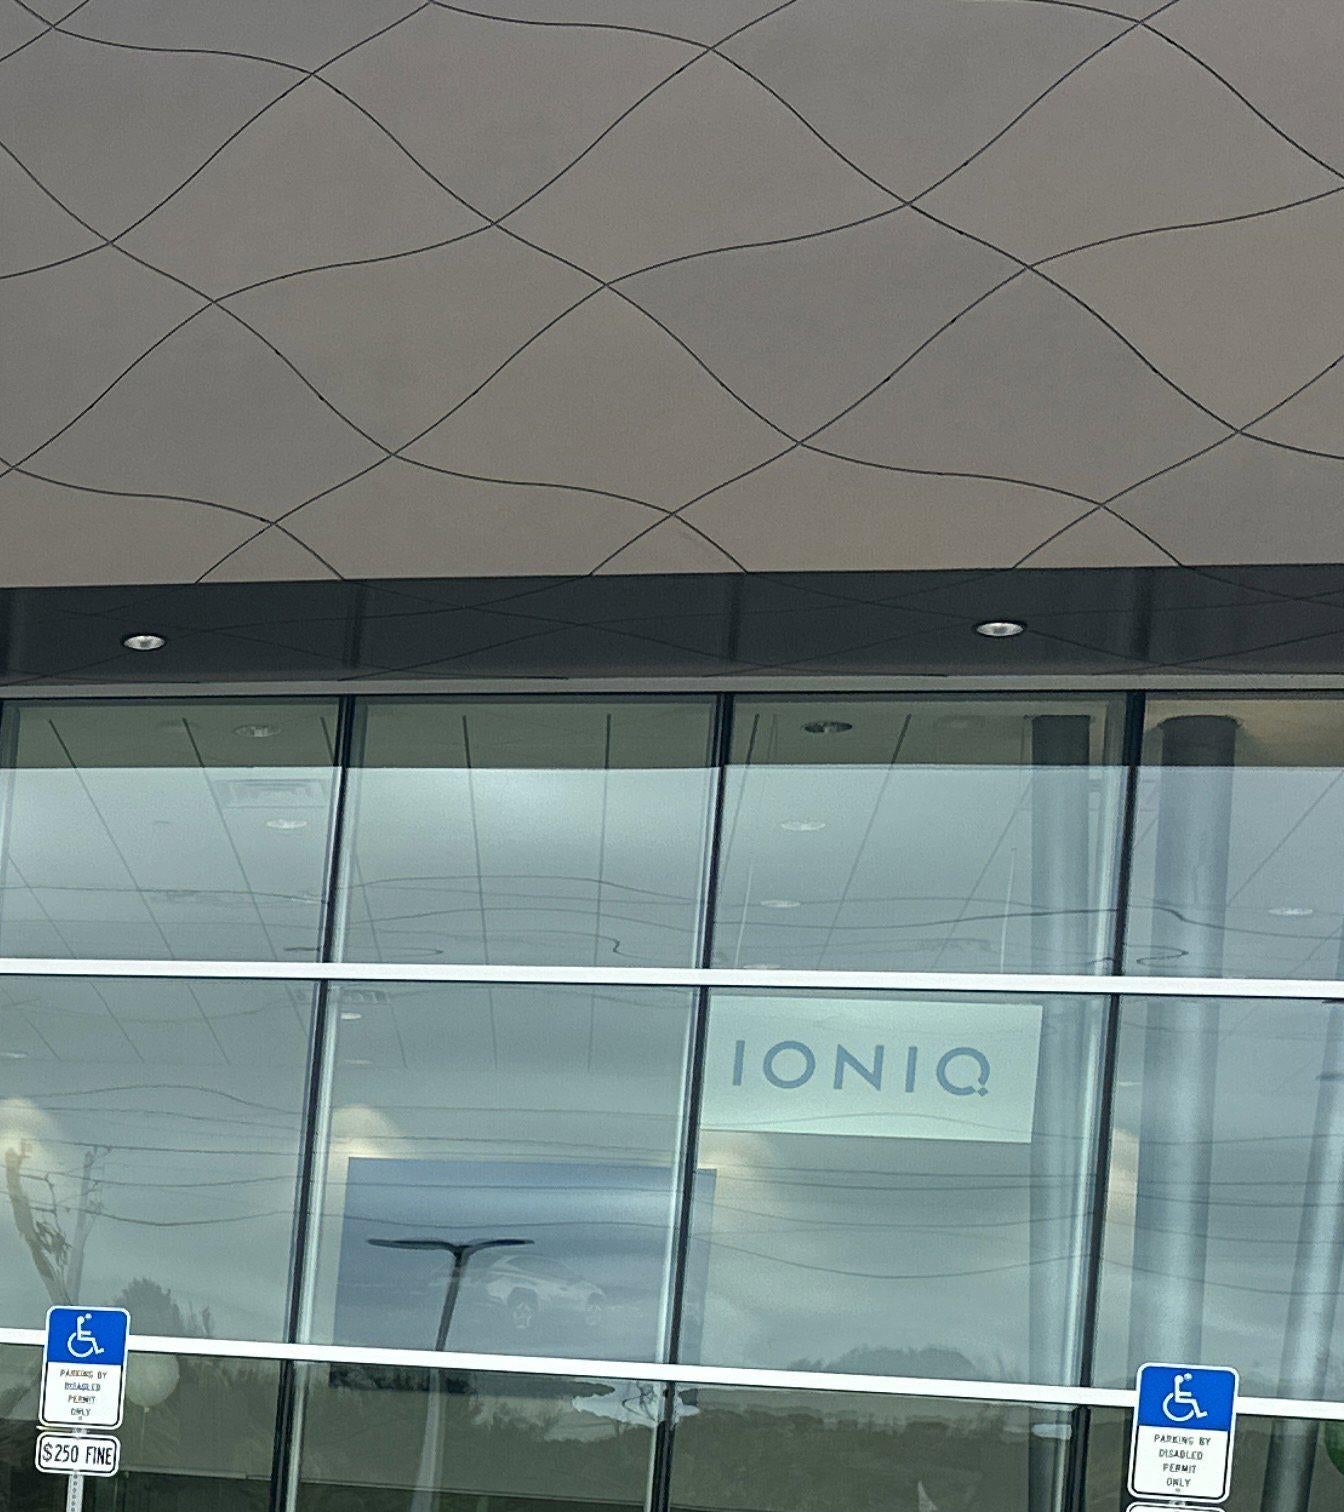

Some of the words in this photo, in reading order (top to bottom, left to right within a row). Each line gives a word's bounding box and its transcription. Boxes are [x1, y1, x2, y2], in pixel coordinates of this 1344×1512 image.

[732, 1039, 991, 1097] IONIQ
[60, 1369, 93, 1379] PARKING
[98, 1371, 107, 1379] BY
[68, 1395, 96, 1403] PERMIT
[71, 1408, 90, 1416] ONLY
[1154, 1434, 1194, 1445] PARKING
[1199, 1436, 1211, 1446] BY
[43, 1442, 78, 1463] $250
[86, 1446, 112, 1465] FINE
[1159, 1448, 1203, 1460] DISABLED
[1163, 1463, 1197, 1474] PERMIT
[1166, 1477, 1191, 1487] ONLY
